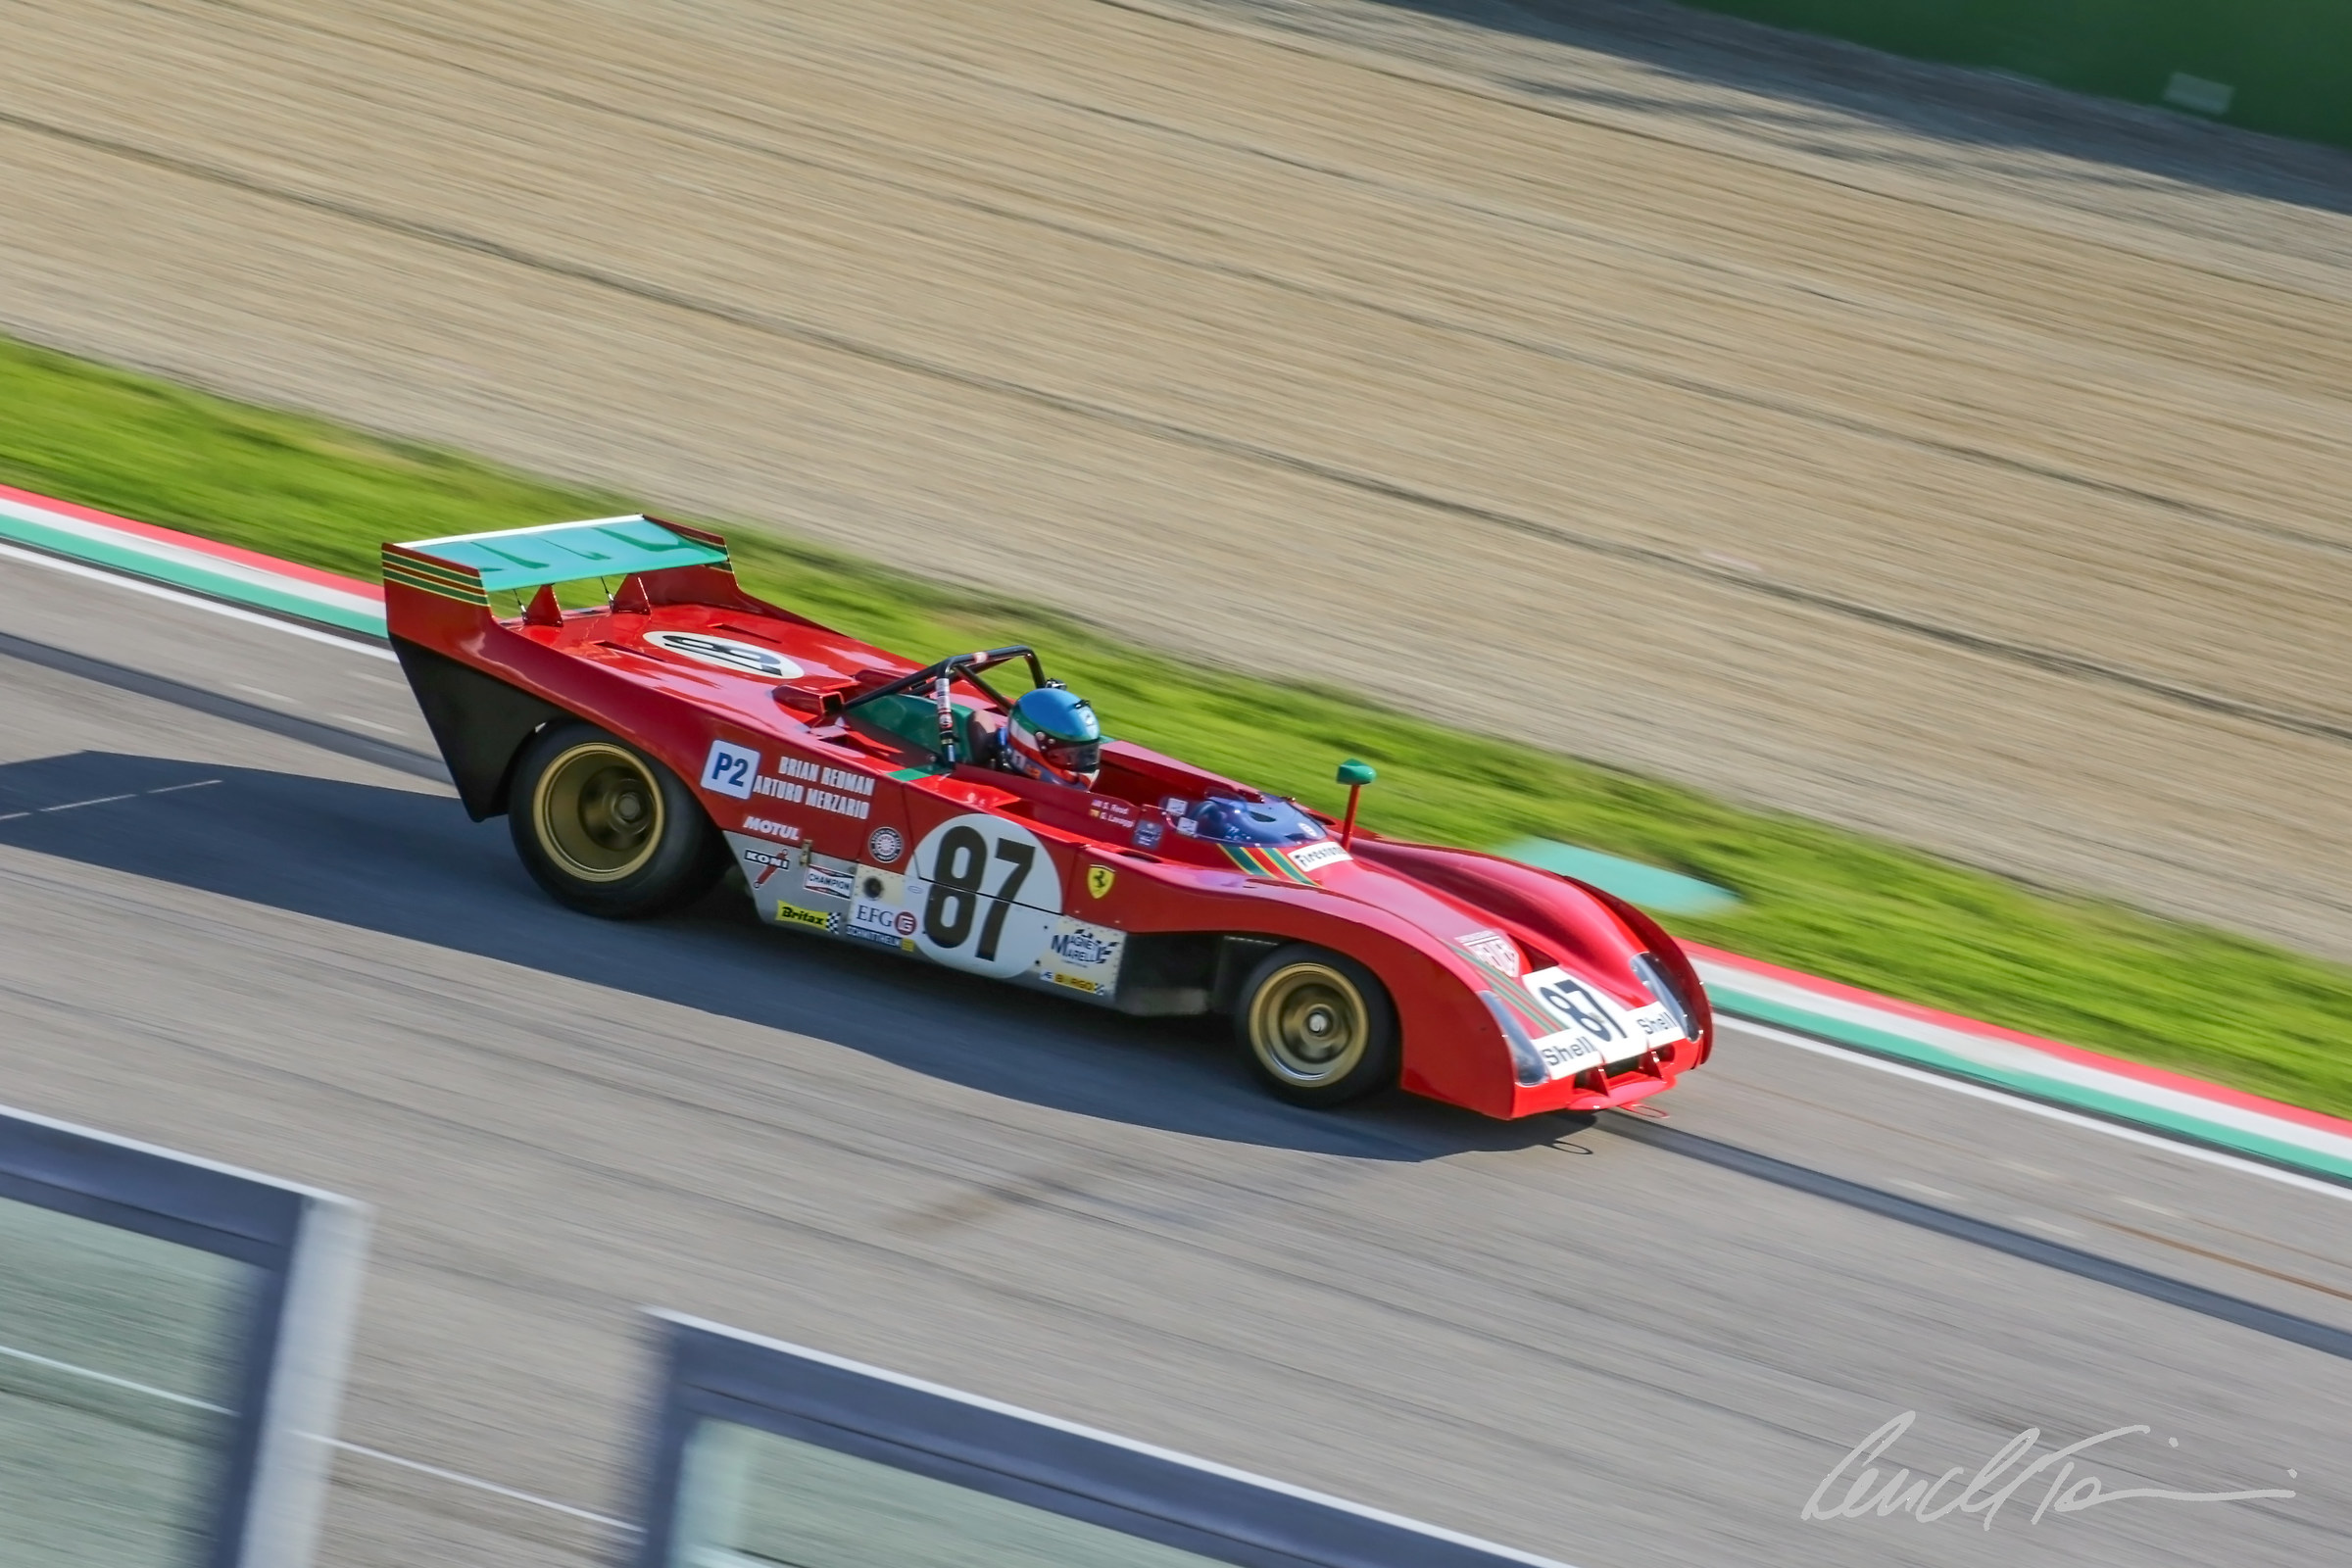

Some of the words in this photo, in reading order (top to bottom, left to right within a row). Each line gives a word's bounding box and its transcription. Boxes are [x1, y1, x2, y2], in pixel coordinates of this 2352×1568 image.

[711, 752, 749, 787] P2
[778, 756, 820, 782] BRIAN
[820, 766, 875, 796] REDMAN
[753, 775, 804, 803] ARTURO
[805, 788, 870, 819] MERZARIO
[743, 816, 800, 841] MOTUL
[747, 851, 788, 868] KONI
[808, 873, 851, 890] CHAMPION
[923, 825, 1036, 962] 87
[781, 906, 824, 926] Britax
[856, 904, 894, 927] EFG
[1539, 979, 1628, 1043] 87
[1637, 1012, 1679, 1036] Shell
[1542, 1036, 1597, 1067] Shell
